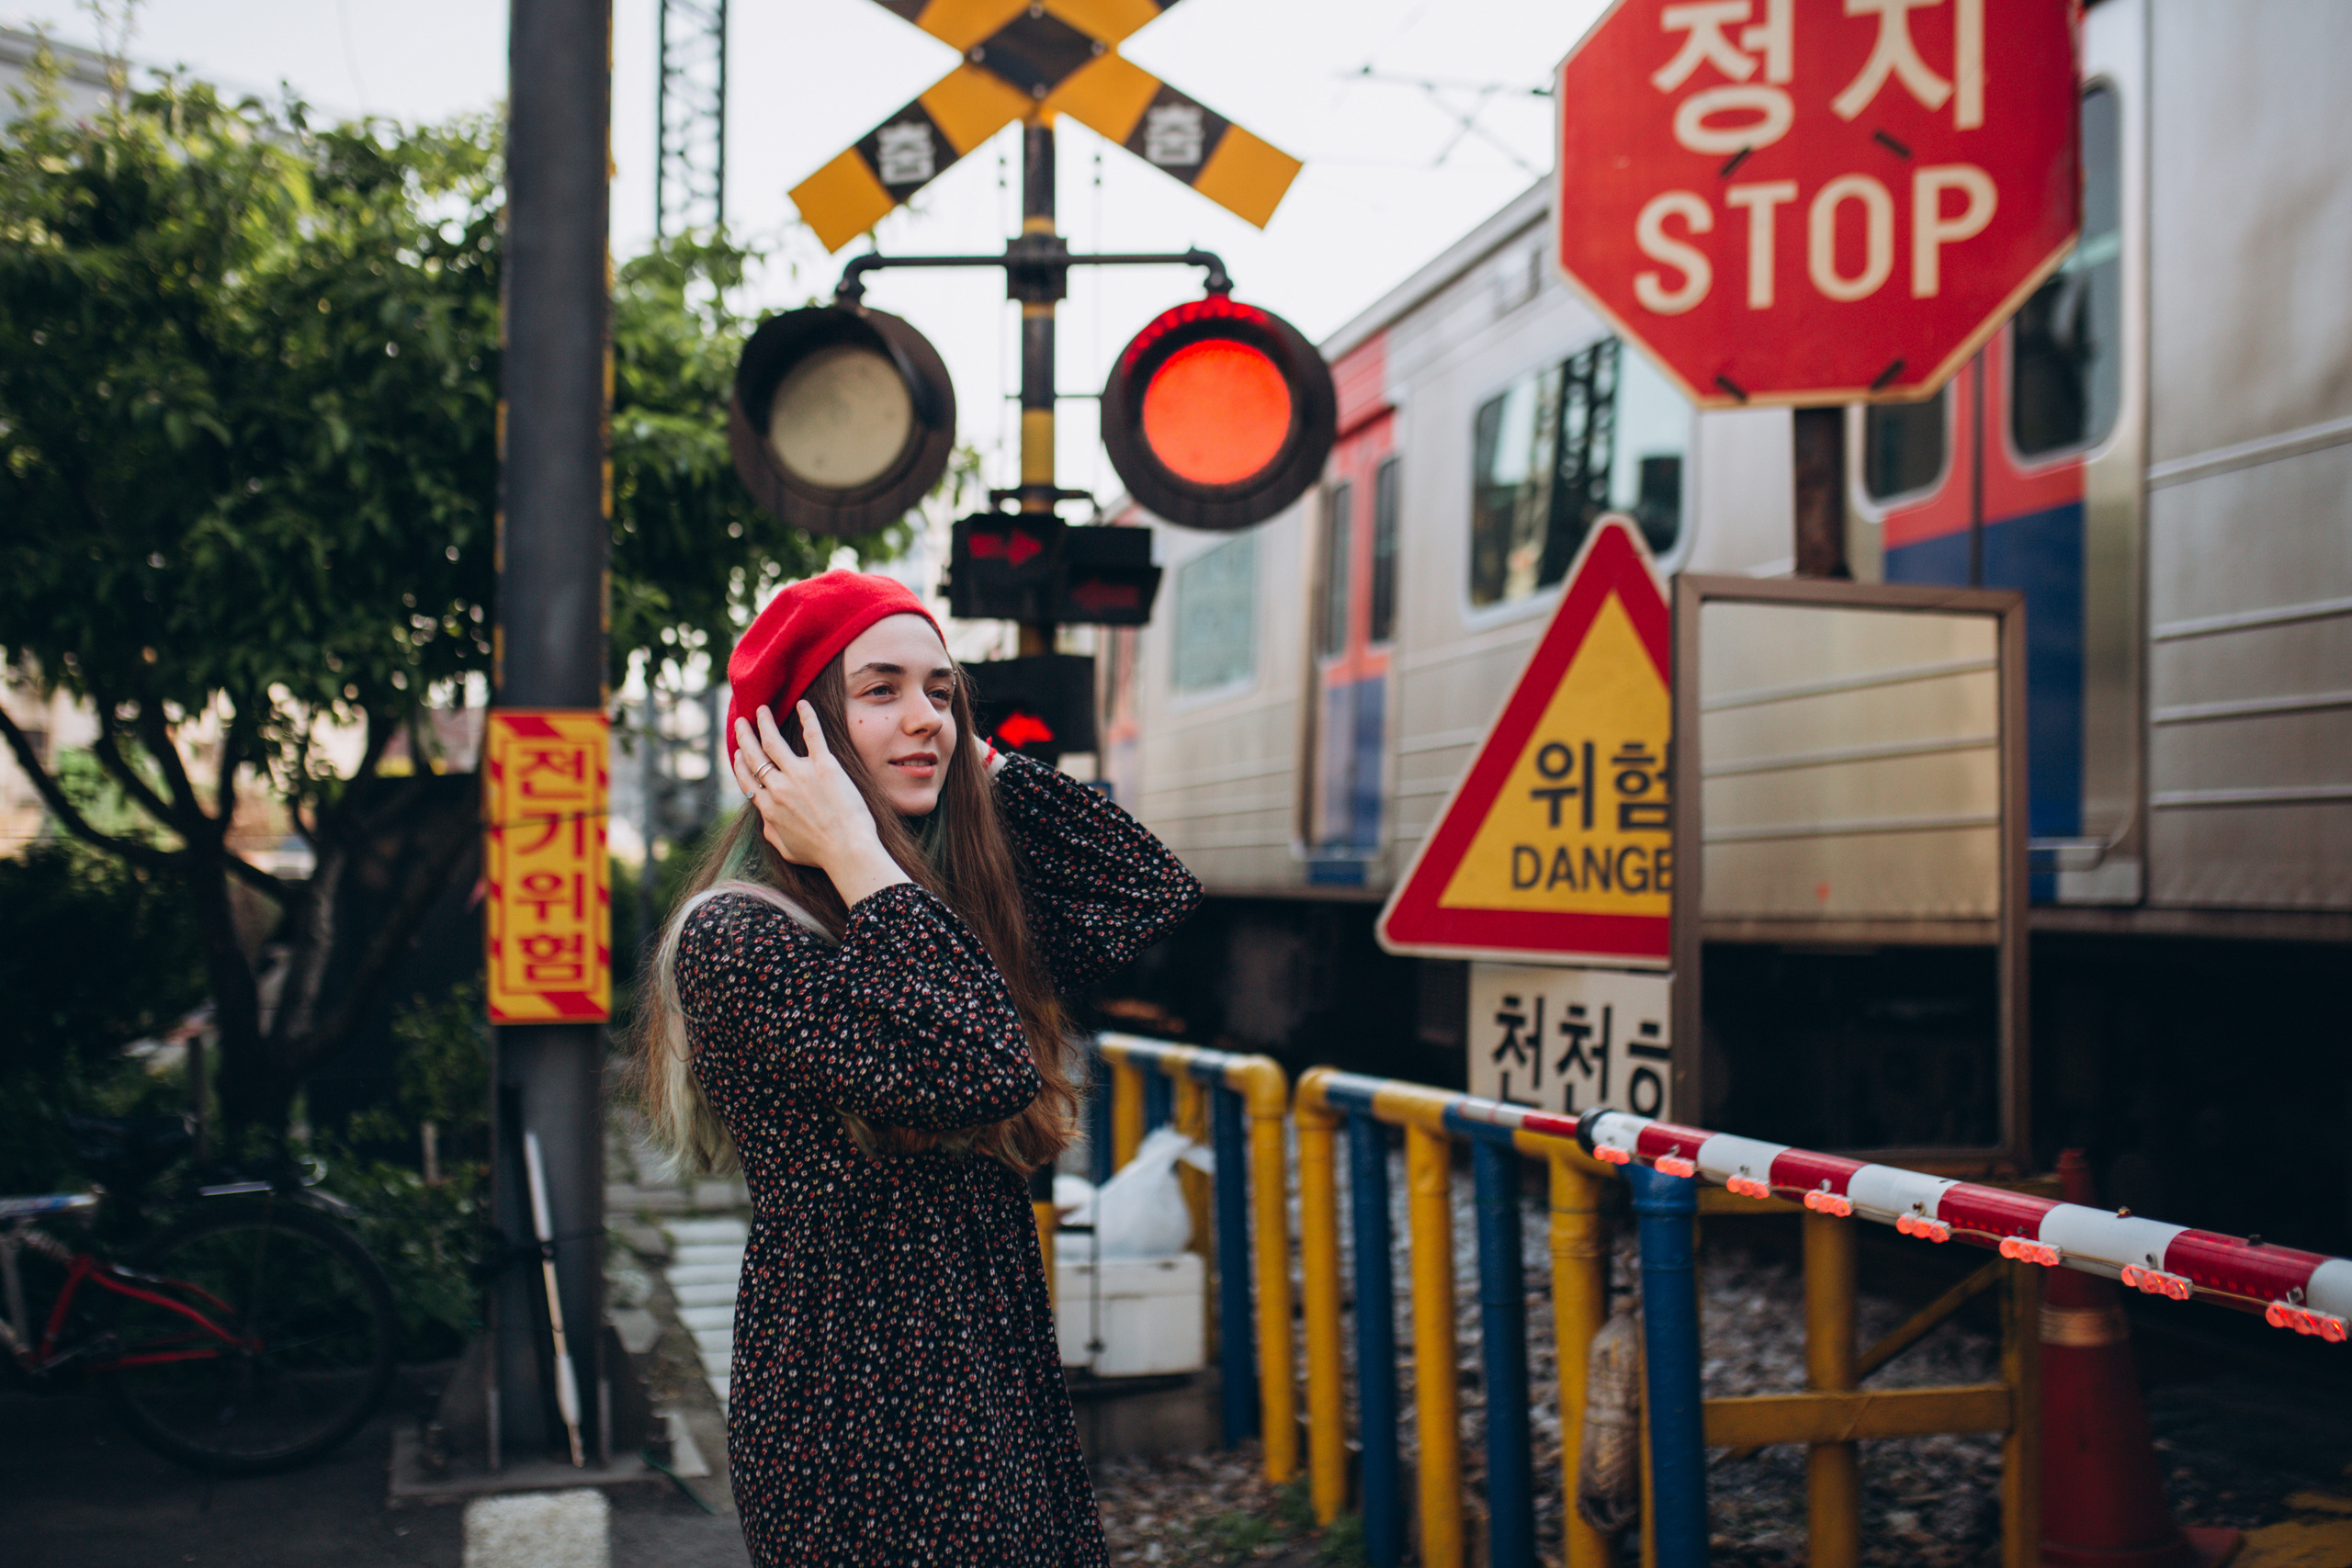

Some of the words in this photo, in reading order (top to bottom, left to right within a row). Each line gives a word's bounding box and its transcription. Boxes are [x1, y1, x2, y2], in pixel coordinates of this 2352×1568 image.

[1649, 0, 1986, 155] 정지
[1634, 163, 1999, 315] STOP
[1530, 740, 1671, 832] 위험
[1511, 844, 1672, 895] DANGE
